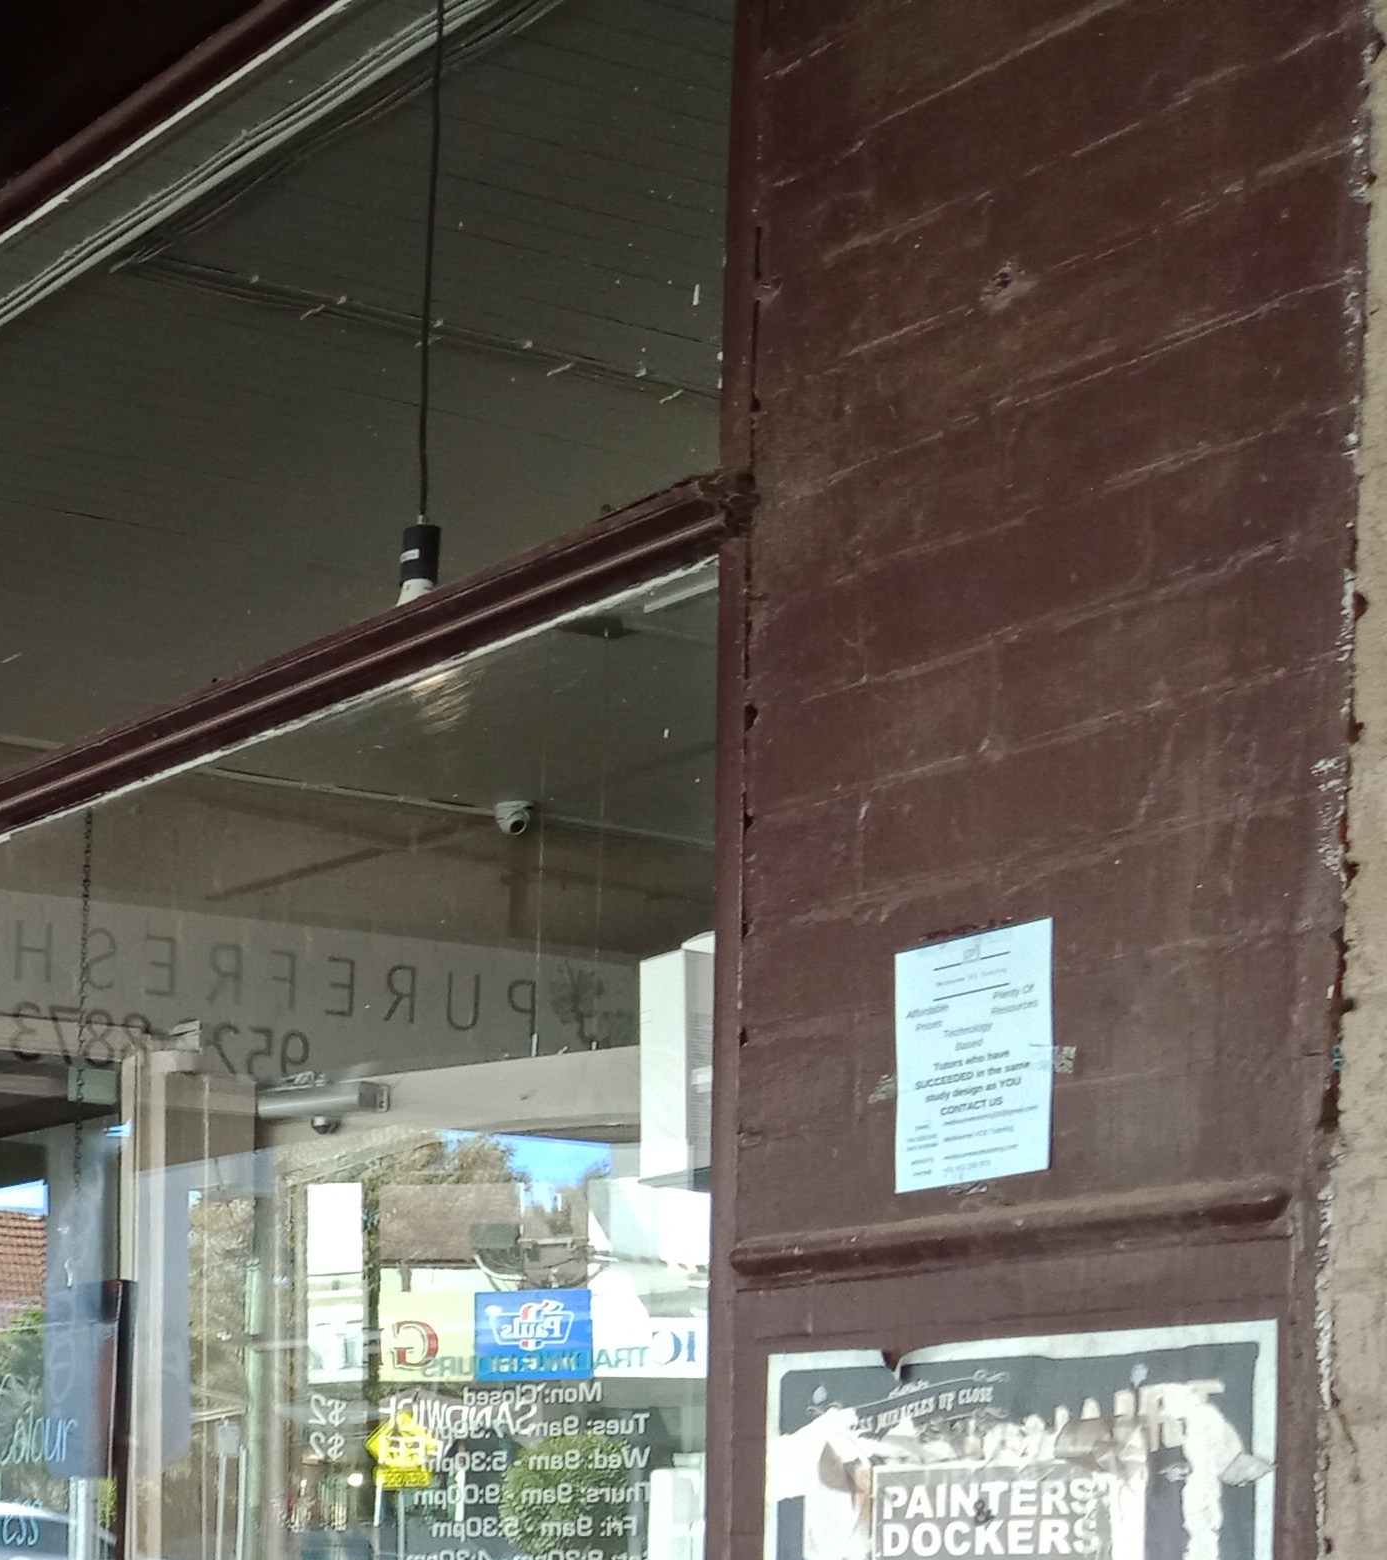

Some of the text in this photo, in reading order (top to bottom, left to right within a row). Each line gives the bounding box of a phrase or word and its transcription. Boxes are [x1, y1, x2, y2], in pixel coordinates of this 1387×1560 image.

[933, 1059, 964, 1072] Tutors
[914, 1071, 974, 1090] SUCCEEDED
[999, 1077, 1022, 1088] YOU
[940, 1099, 988, 1116] CONTACT
[989, 1096, 1004, 1106] US
[882, 1477, 1098, 1520] PAINTERS
[882, 1519, 1100, 1557] DOCKERS
